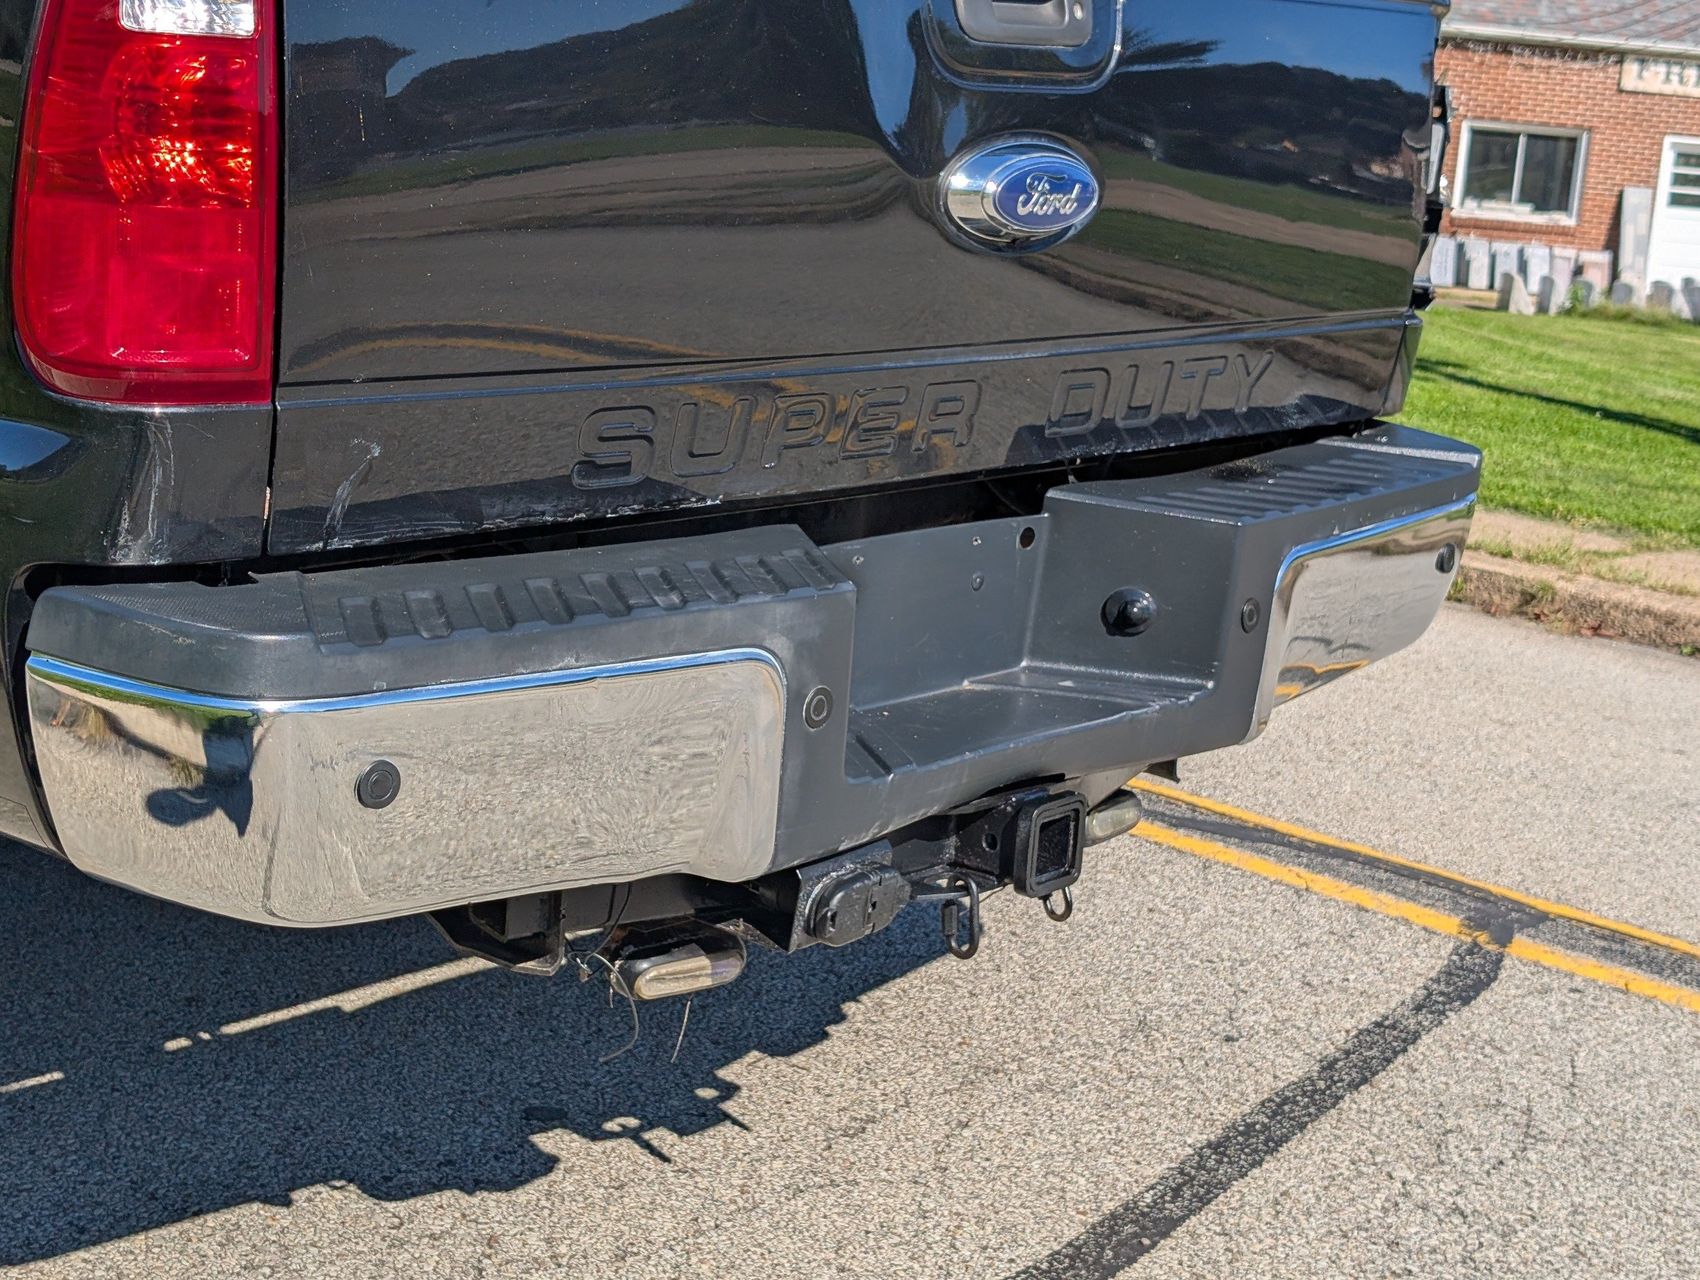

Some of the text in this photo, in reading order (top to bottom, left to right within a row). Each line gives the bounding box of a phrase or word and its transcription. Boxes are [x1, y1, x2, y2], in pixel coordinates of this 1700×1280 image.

[1017, 172, 1082, 216] Ford
[571, 350, 1275, 490] SUPER DUTY
